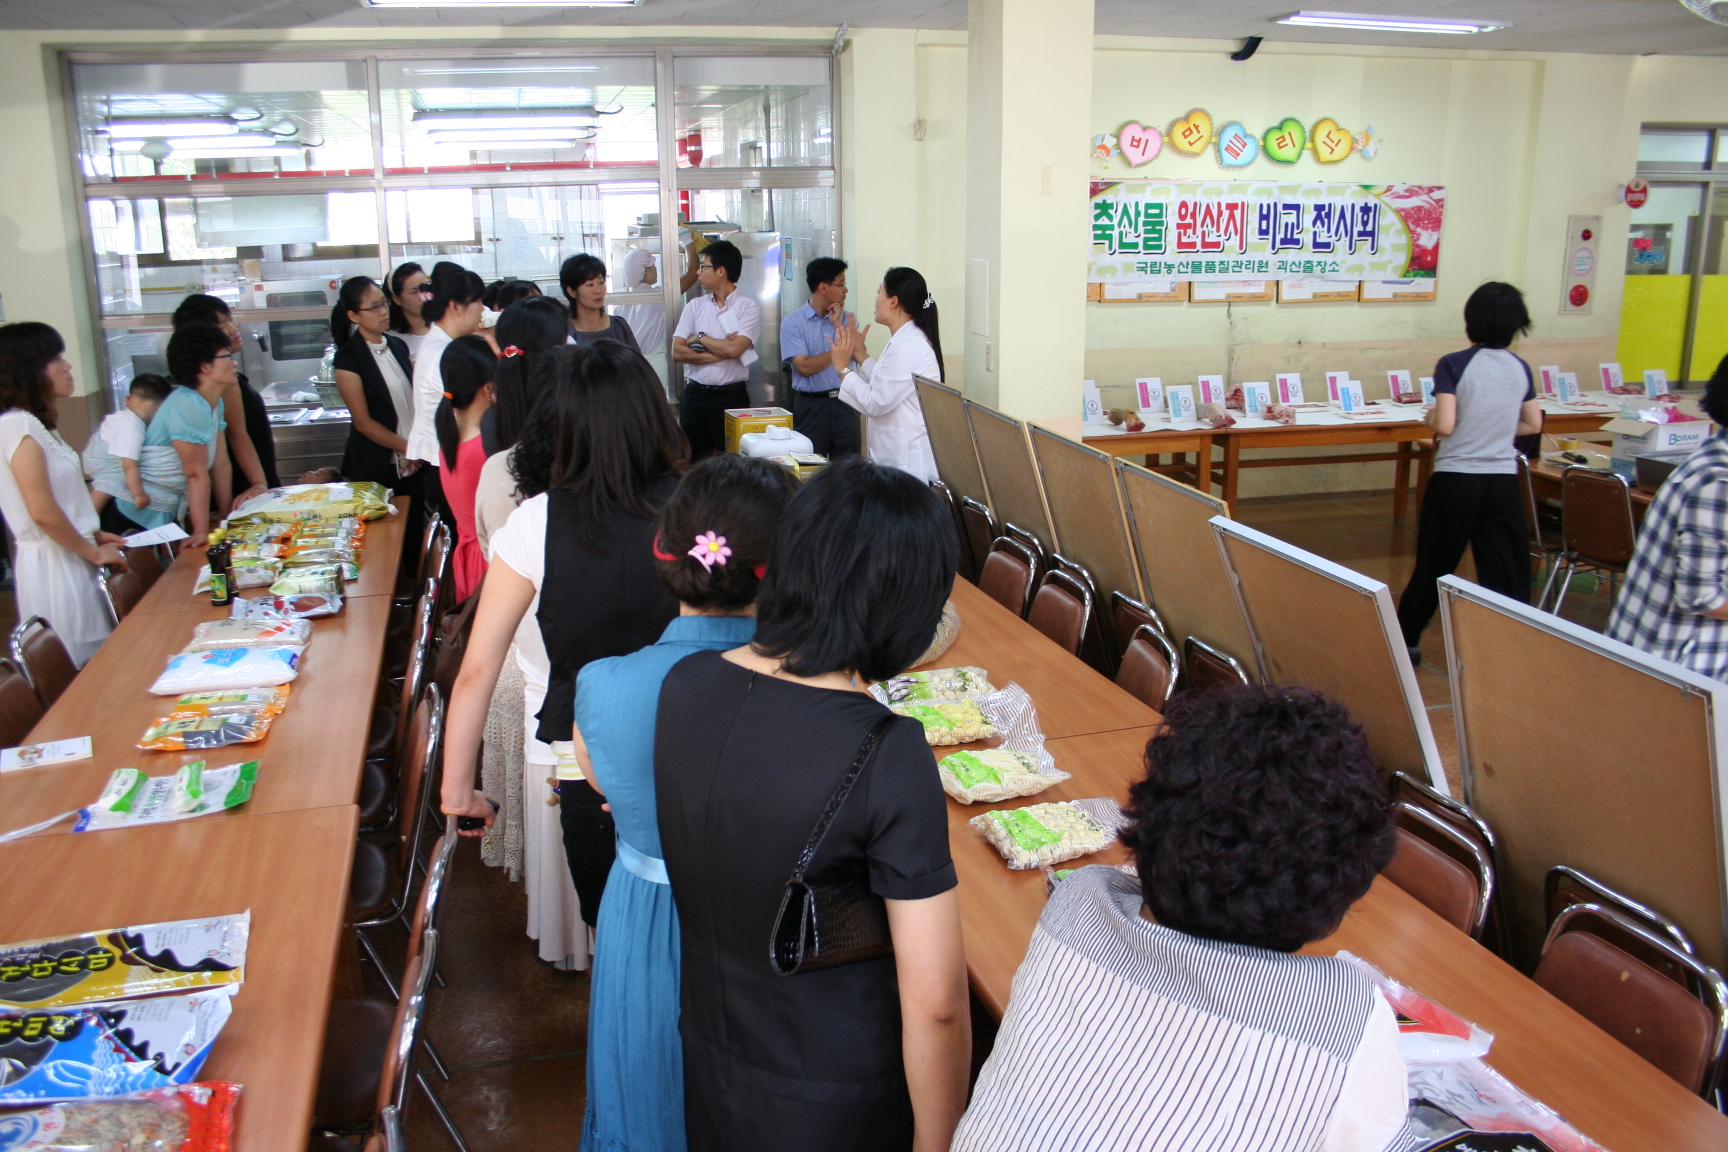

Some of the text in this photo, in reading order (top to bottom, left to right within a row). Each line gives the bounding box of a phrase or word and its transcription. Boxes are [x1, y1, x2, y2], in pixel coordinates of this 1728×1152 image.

[1091, 198, 1379, 254] 축산물 원산지 비교 전시회
[1135, 259, 1341, 275] 국립농산물품질관리원 괴산출장소
